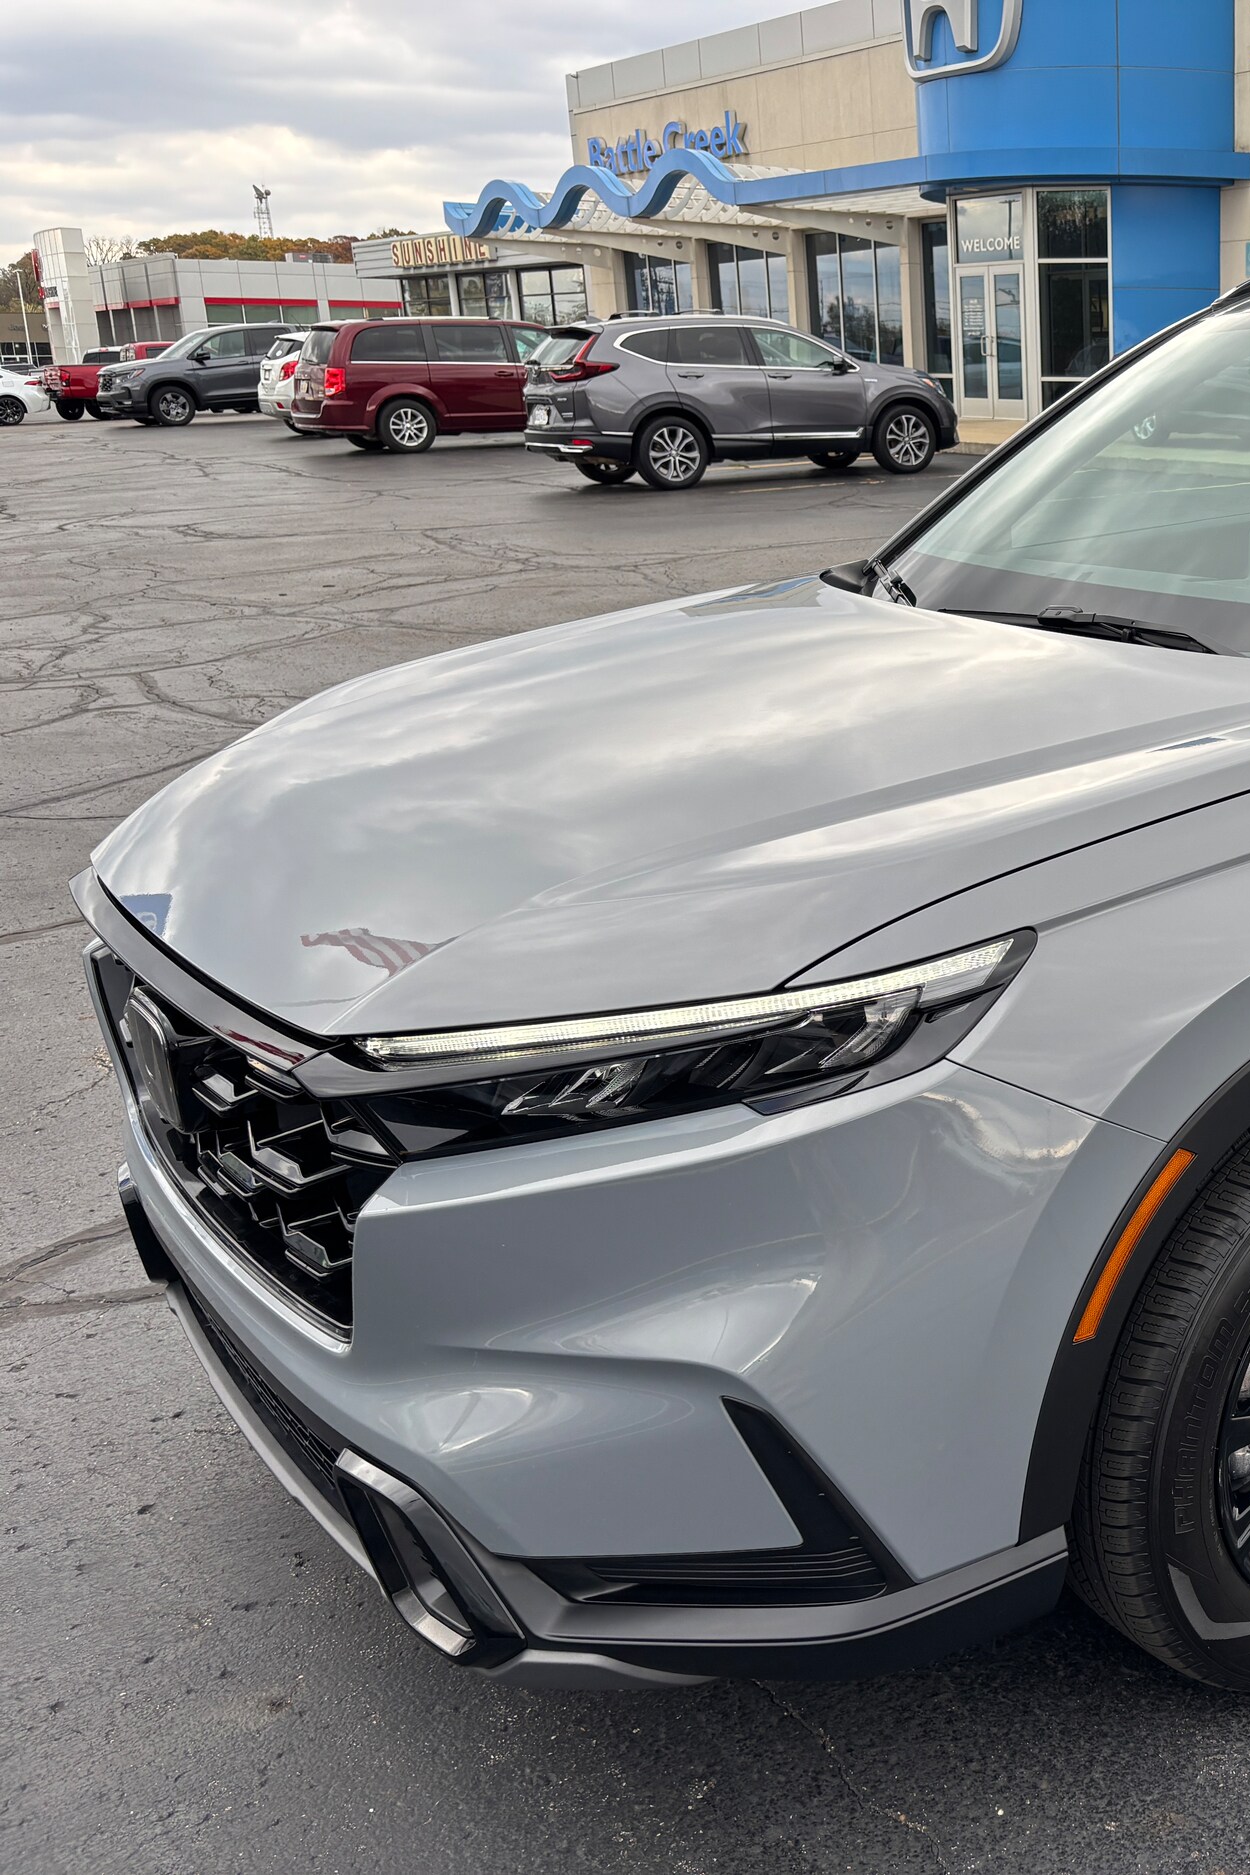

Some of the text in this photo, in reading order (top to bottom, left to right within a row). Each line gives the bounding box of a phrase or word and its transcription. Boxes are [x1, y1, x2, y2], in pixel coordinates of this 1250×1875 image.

[588, 110, 747, 175] Battle Creek
[961, 235, 1020, 253] WELCOME
